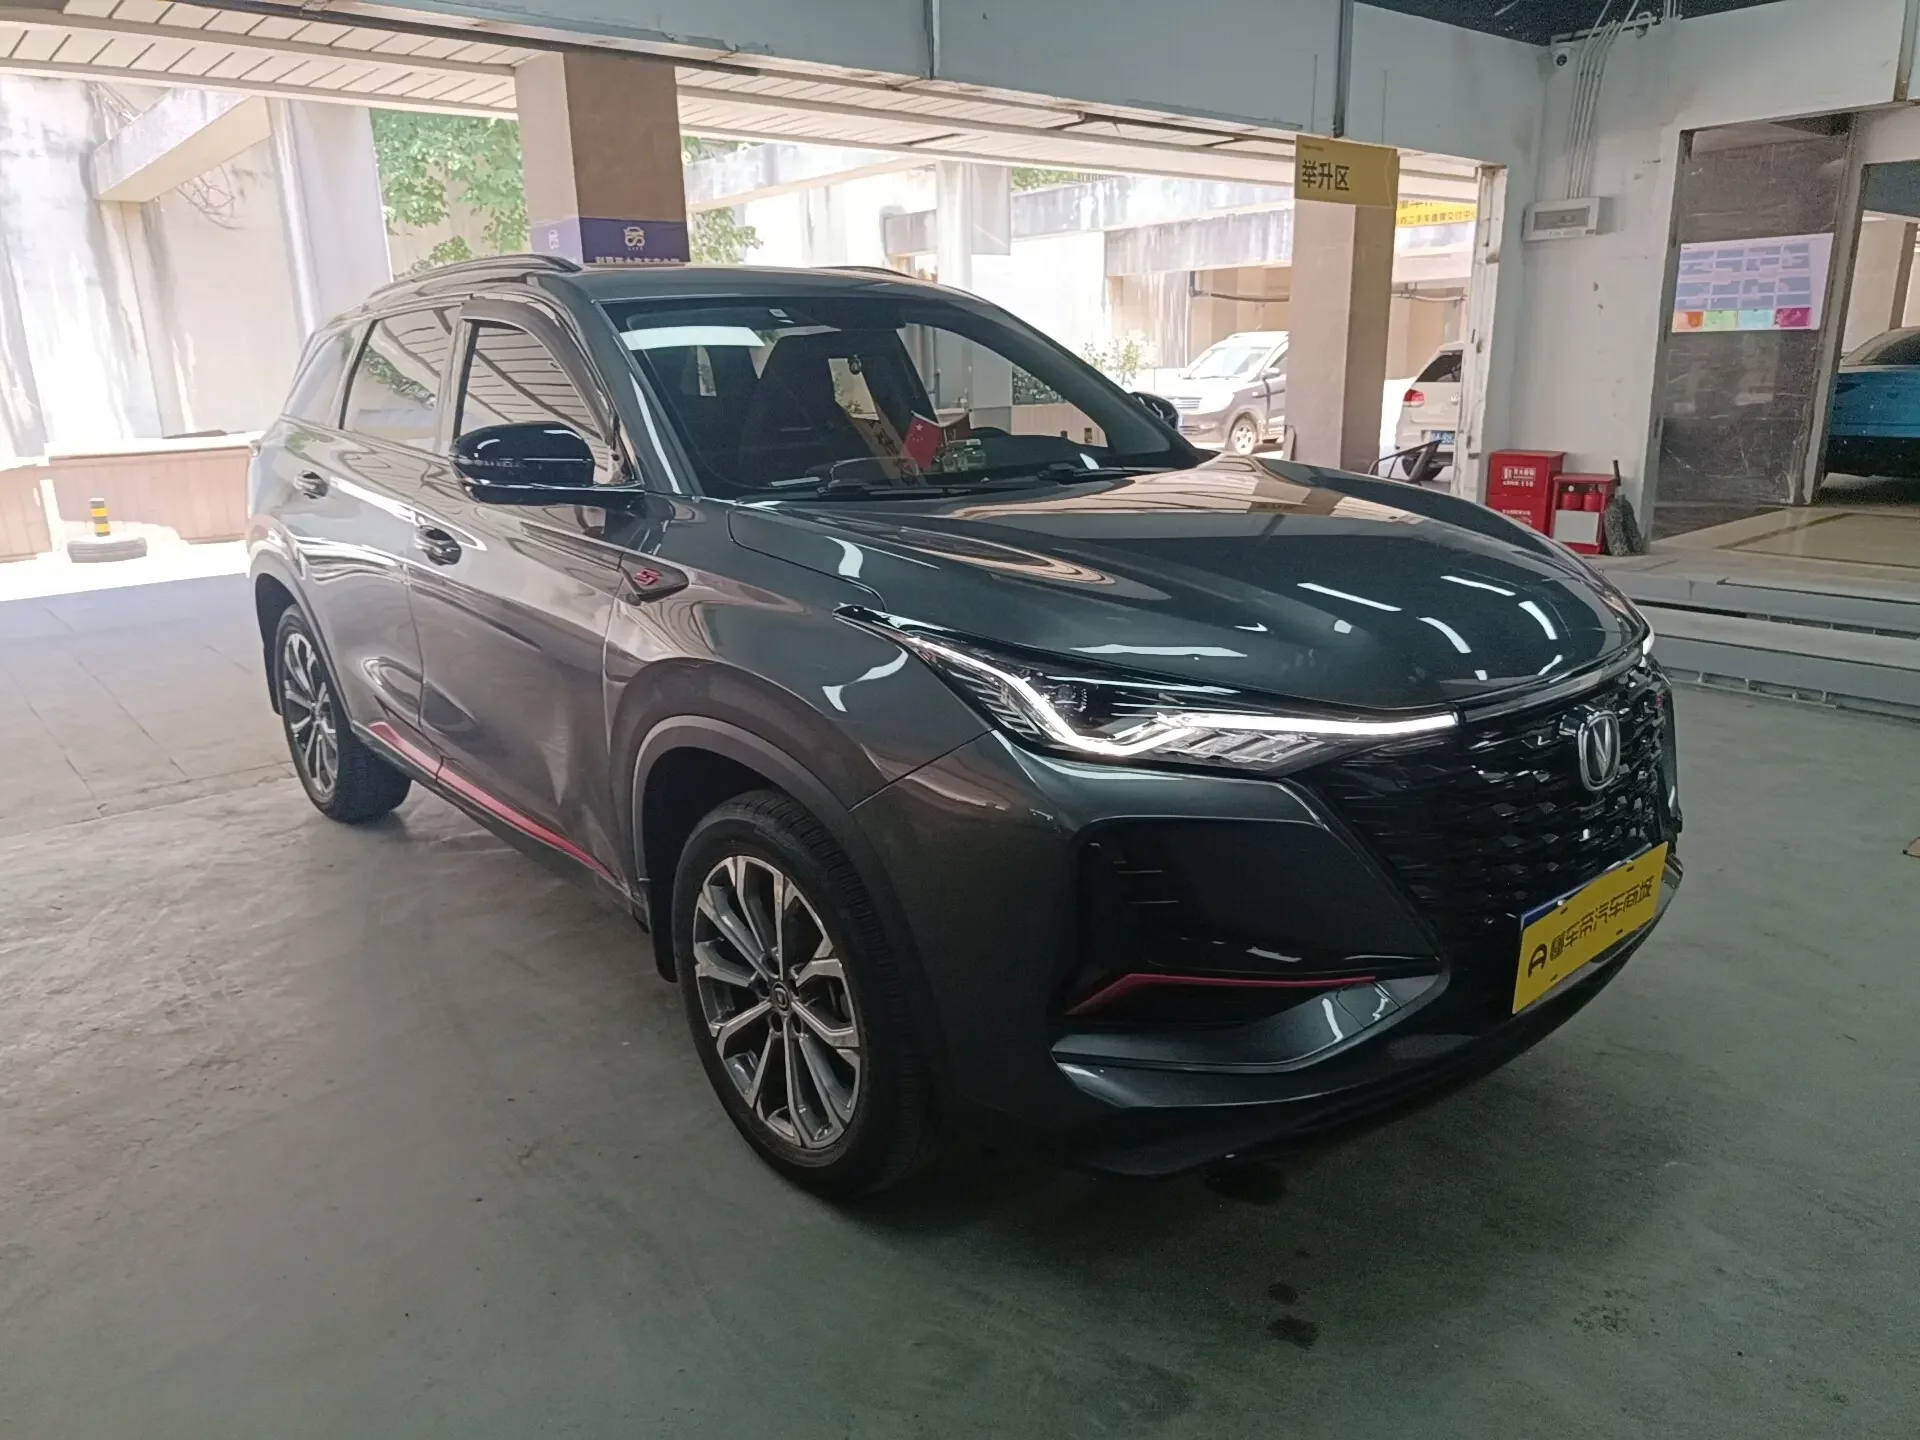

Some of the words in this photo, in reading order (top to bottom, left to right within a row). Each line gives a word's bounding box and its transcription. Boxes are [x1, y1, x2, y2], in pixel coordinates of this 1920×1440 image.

[1302, 159, 1350, 191] 举升区
[1549, 876, 1655, 961] 懂车帝汽车商城
